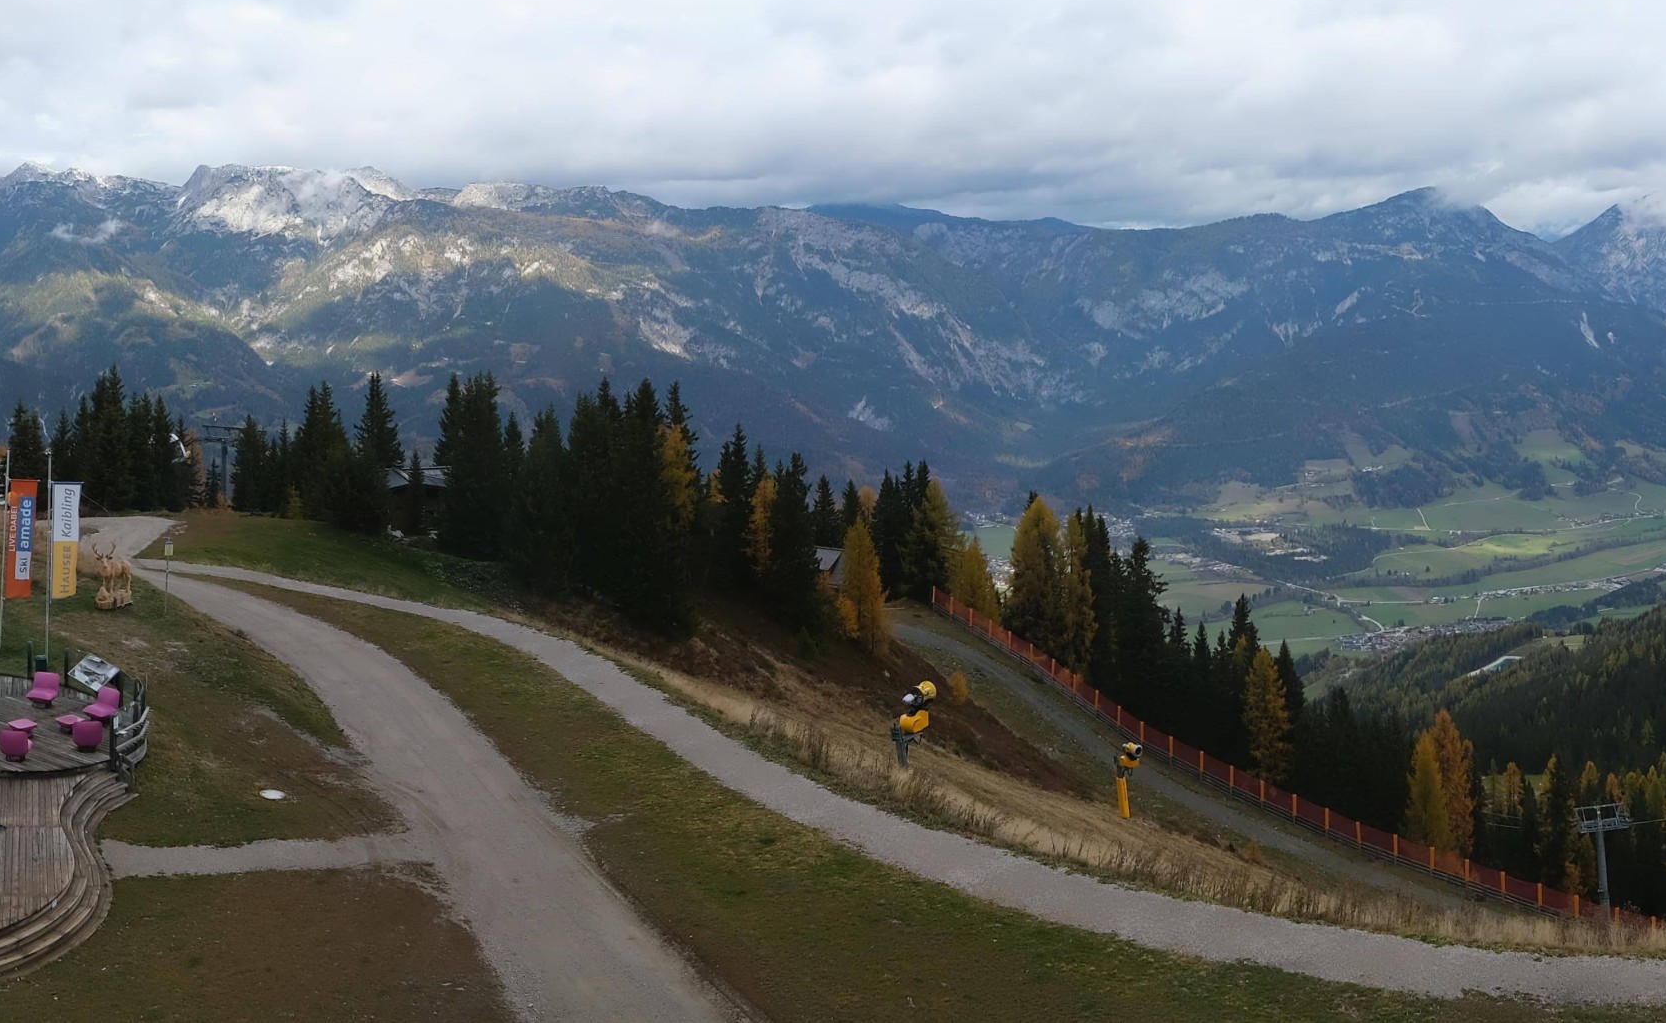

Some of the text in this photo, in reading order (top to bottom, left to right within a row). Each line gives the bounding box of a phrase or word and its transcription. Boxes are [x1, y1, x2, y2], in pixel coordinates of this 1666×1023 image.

[8, 532, 16, 552] LIVE
[19, 499, 32, 573] Ski amade
[60, 488, 76, 594] HAUSER Kaibling
